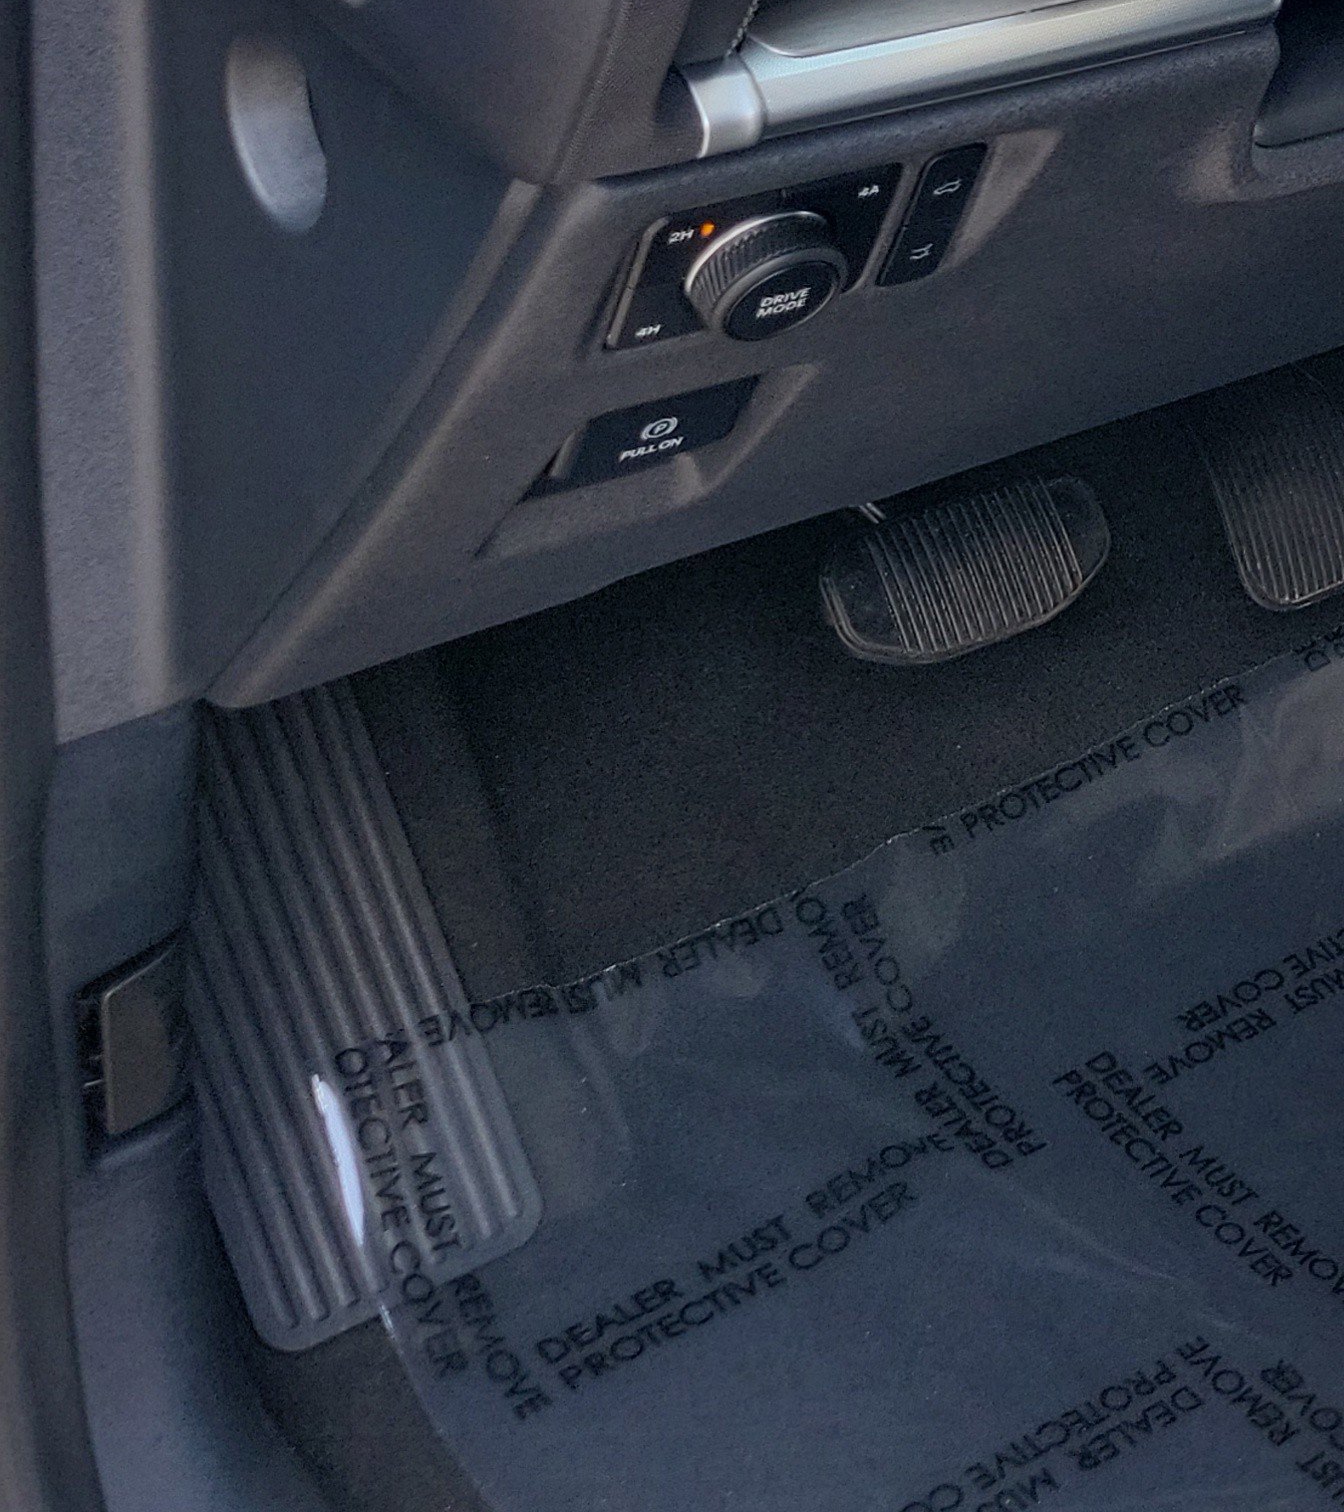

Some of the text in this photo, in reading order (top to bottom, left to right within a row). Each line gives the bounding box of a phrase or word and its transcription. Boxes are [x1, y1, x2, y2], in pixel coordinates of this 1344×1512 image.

[667, 228, 695, 245] 2H
[857, 184, 880, 199] 4A
[635, 323, 661, 338] 4H
[755, 298, 808, 320] MODE
[759, 286, 812, 309] DRIVE
[619, 436, 684, 464] PULL ON
[961, 685, 1247, 838] PROTECTIVE COVER
[841, 894, 1047, 1157] PROTECTIVE COVER
[852, 1006, 923, 1080] MUST
[1174, 967, 1287, 1033] COVER
[1142, 1008, 1278, 1085] REMOVE
[915, 1081, 1014, 1171] DEALER
[1085, 1050, 1185, 1143] DEALER
[1178, 1144, 1261, 1208] MUST
[1053, 1067, 1297, 1287] PROTECTIVE COVER
[410, 1150, 463, 1254] MUST
[452, 1272, 554, 1423] REMOVE
[537, 1133, 955, 1366] DEALER MUST REMOVE
[559, 1181, 920, 1390] PROTECTIVE COVER
[388, 1240, 469, 1380] COVER
[966, 1359, 1178, 1490] PROTECTIVE
[1068, 1385, 1208, 1472] DEALER
[1175, 1335, 1303, 1448] REMOVE
